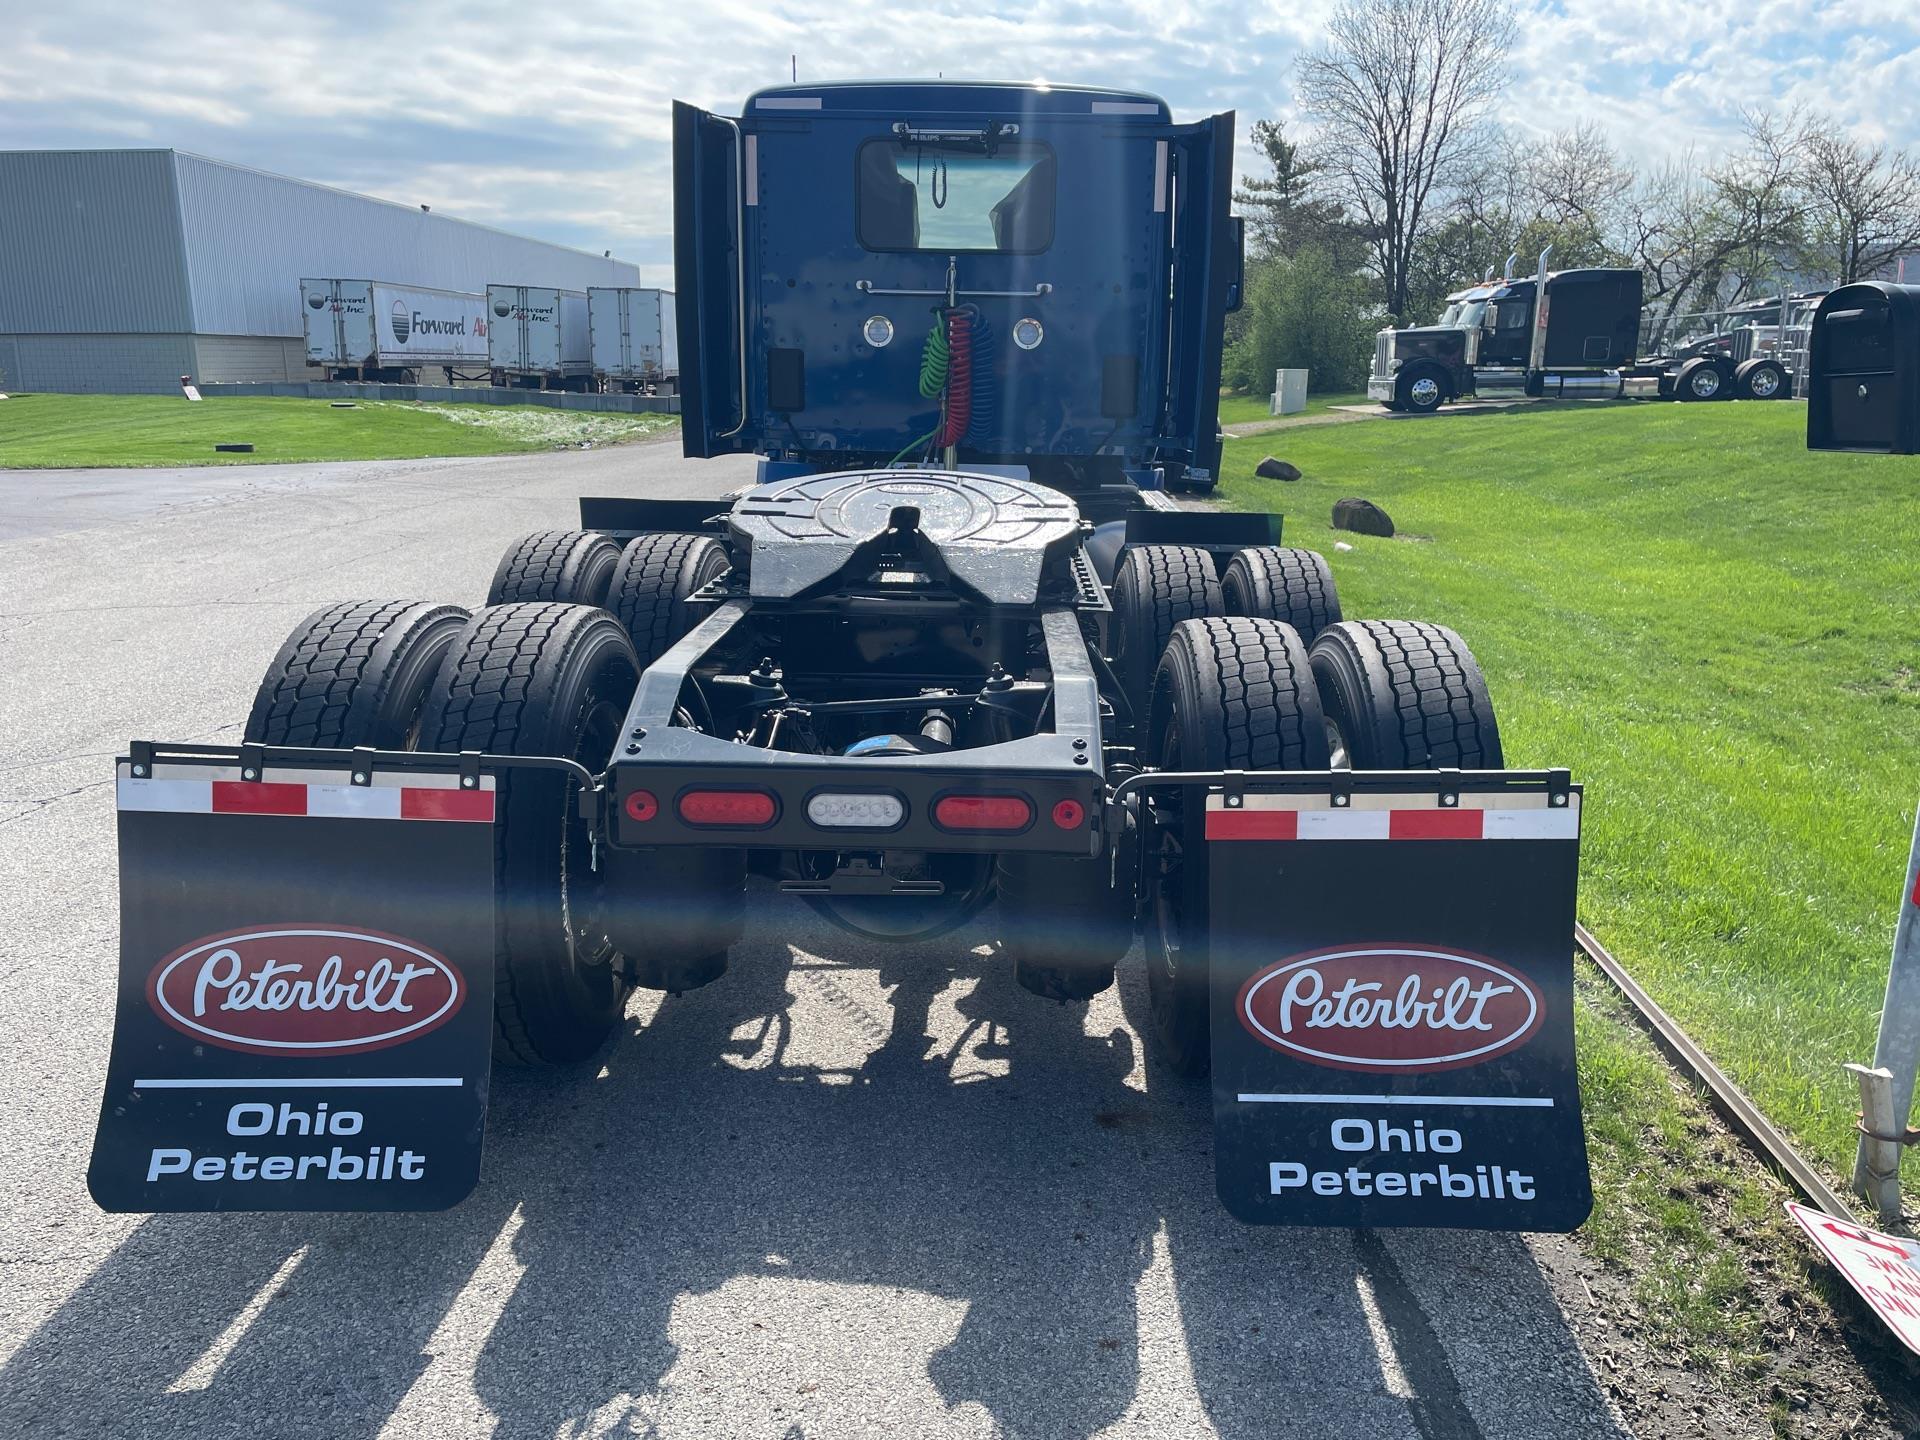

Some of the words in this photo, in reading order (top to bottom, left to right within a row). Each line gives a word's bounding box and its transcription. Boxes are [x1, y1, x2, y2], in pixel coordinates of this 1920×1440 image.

[412, 311, 465, 336] Forward
[472, 316, 487, 337] Air
[511, 304, 553, 314] Forward
[194, 948, 436, 1017] Peterbilt
[1280, 968, 1514, 1034] Peterbilt
[226, 1102, 364, 1136] Ohio
[1331, 1118, 1462, 1153] Ohio
[146, 1146, 426, 1182] Peterbilt
[1269, 1162, 1536, 1200] Peterbilt
